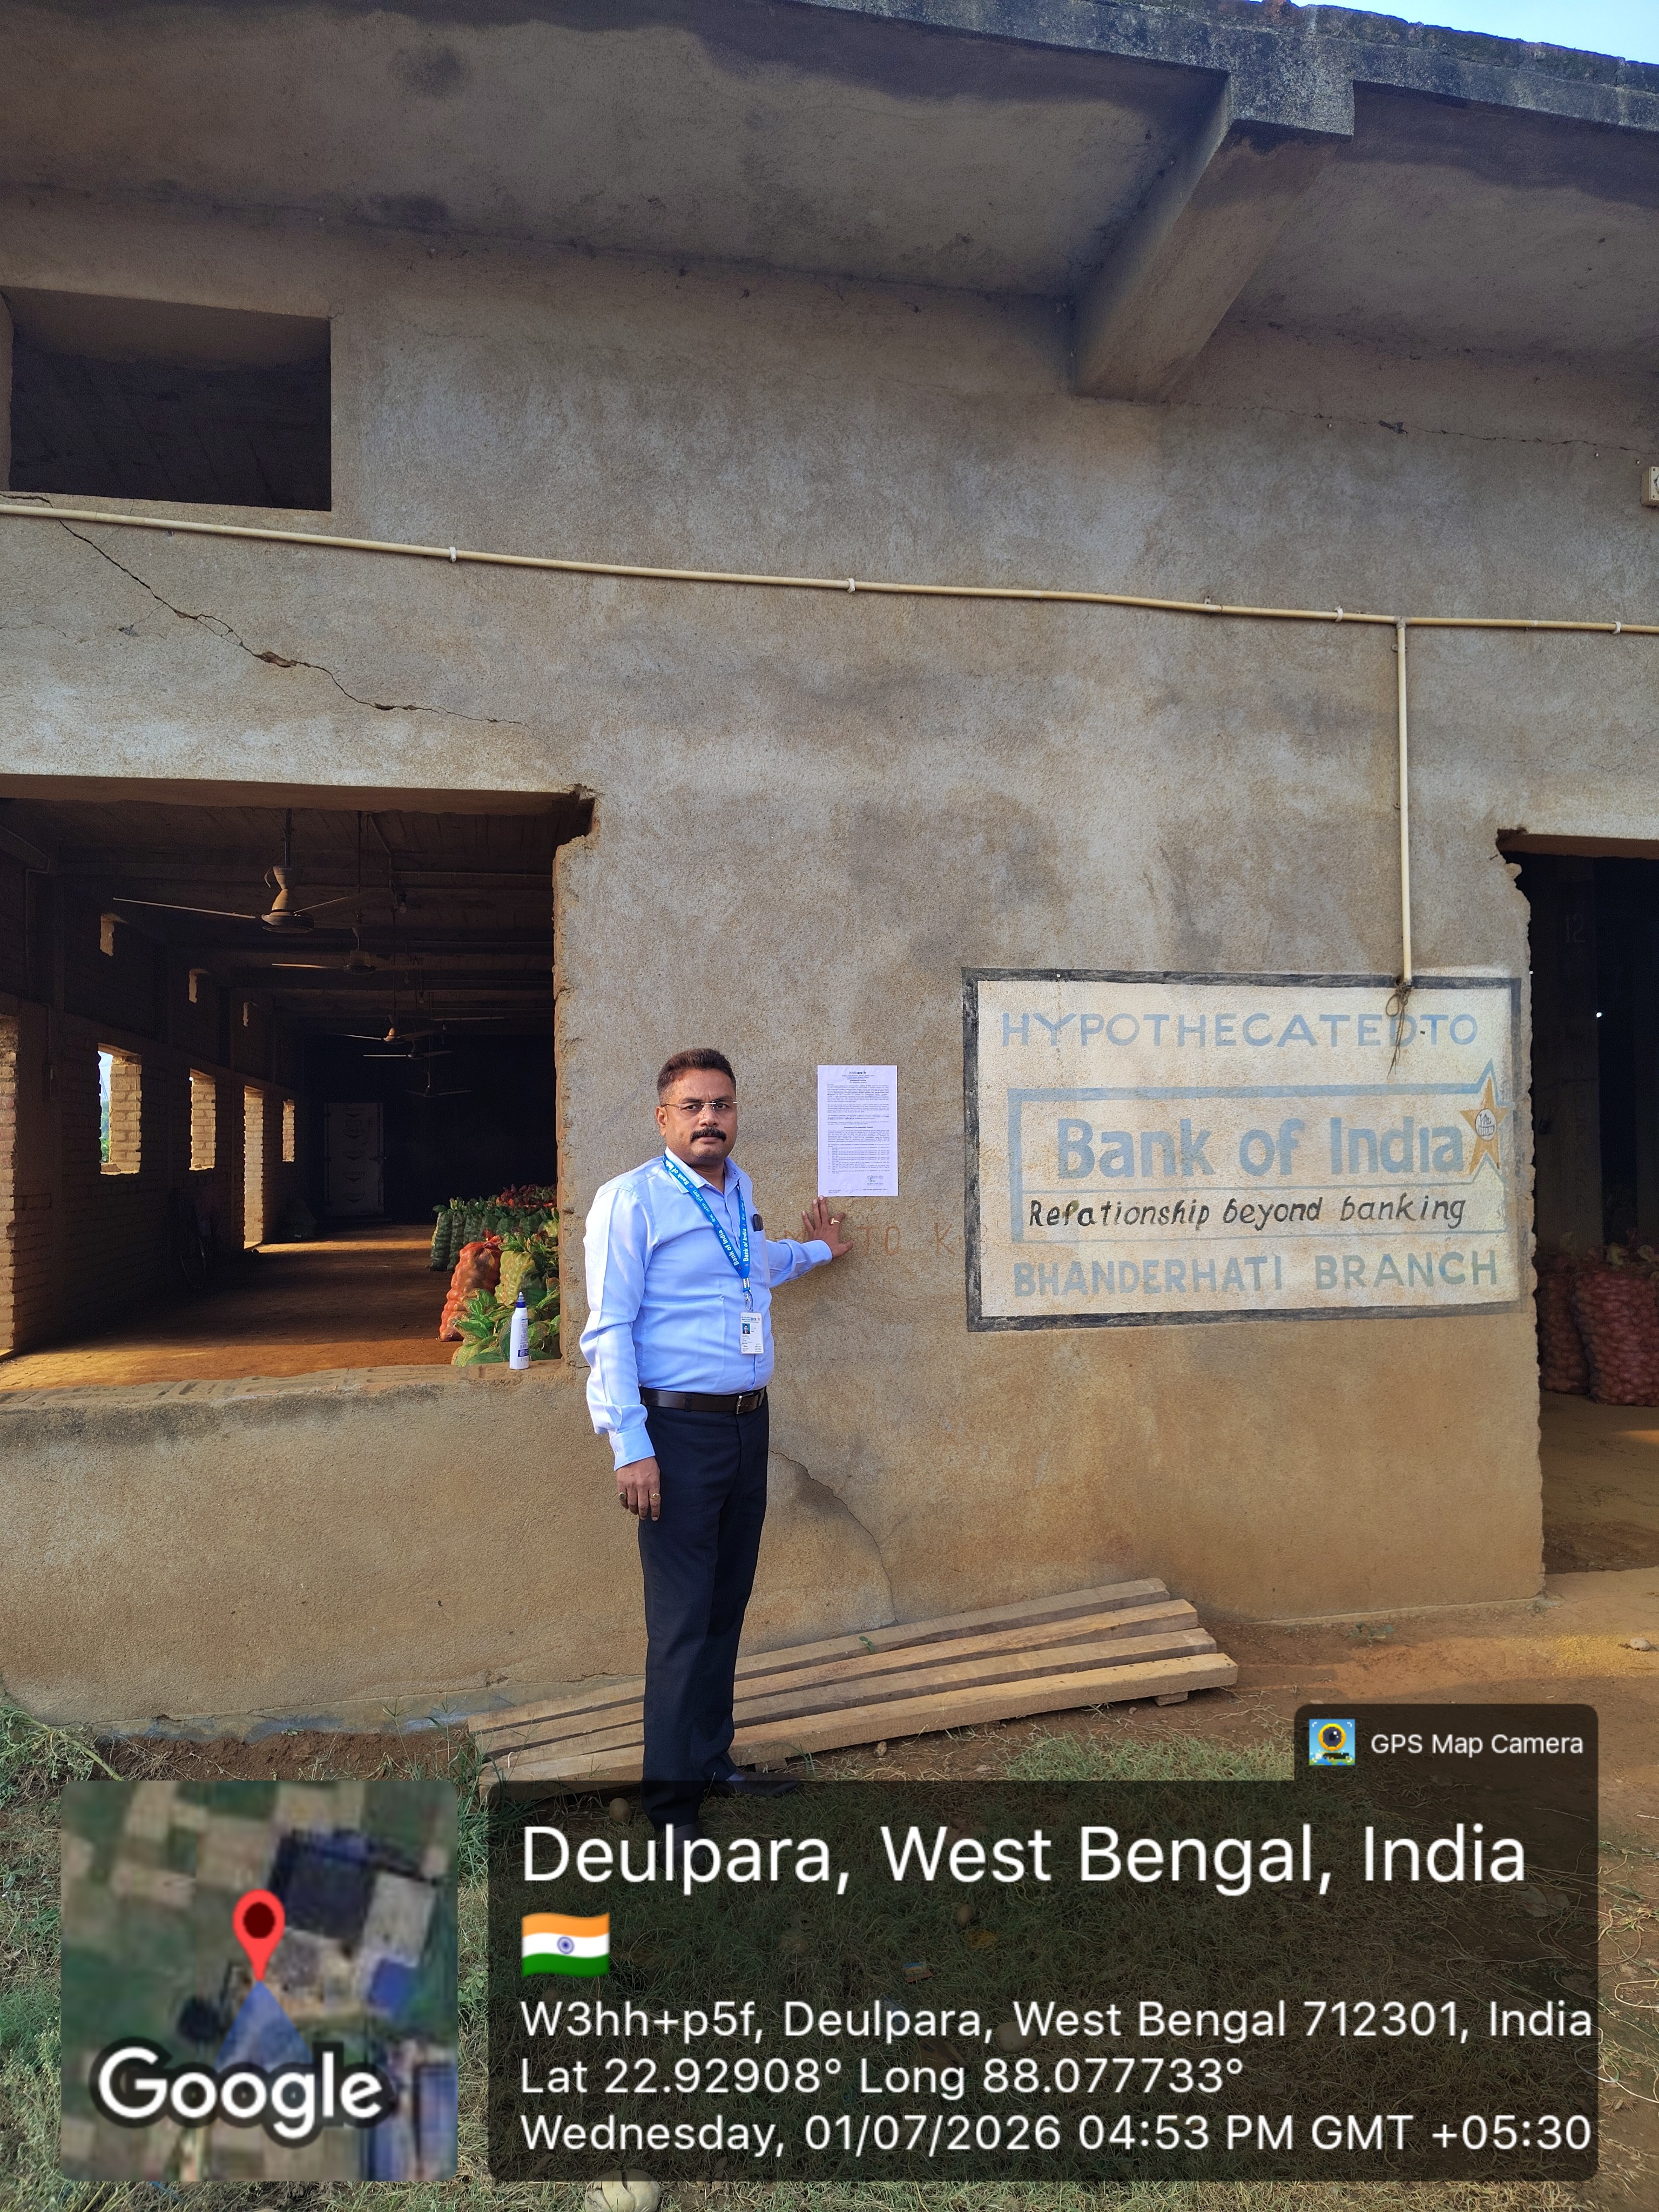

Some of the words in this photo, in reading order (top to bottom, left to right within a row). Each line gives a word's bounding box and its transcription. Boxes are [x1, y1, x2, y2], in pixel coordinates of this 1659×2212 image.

[1001, 1012, 1417, 1048] HYPOTHECATED
[1420, 1013, 1478, 1045] TO
[1057, 1118, 1216, 1179] Bank
[1238, 1118, 1306, 1177] of
[1330, 1117, 1465, 1174] India
[677, 1172, 690, 1185] Bank
[1029, 1196, 1210, 1231] Relationship
[1222, 1196, 1323, 1231] beyond
[1339, 1193, 1467, 1229] banking
[719, 1229, 729, 1245] India
[729, 1250, 739, 1266] Bank
[1013, 1254, 1283, 1297] BHANDERHATI
[1314, 1250, 1498, 1291] BRANCH
